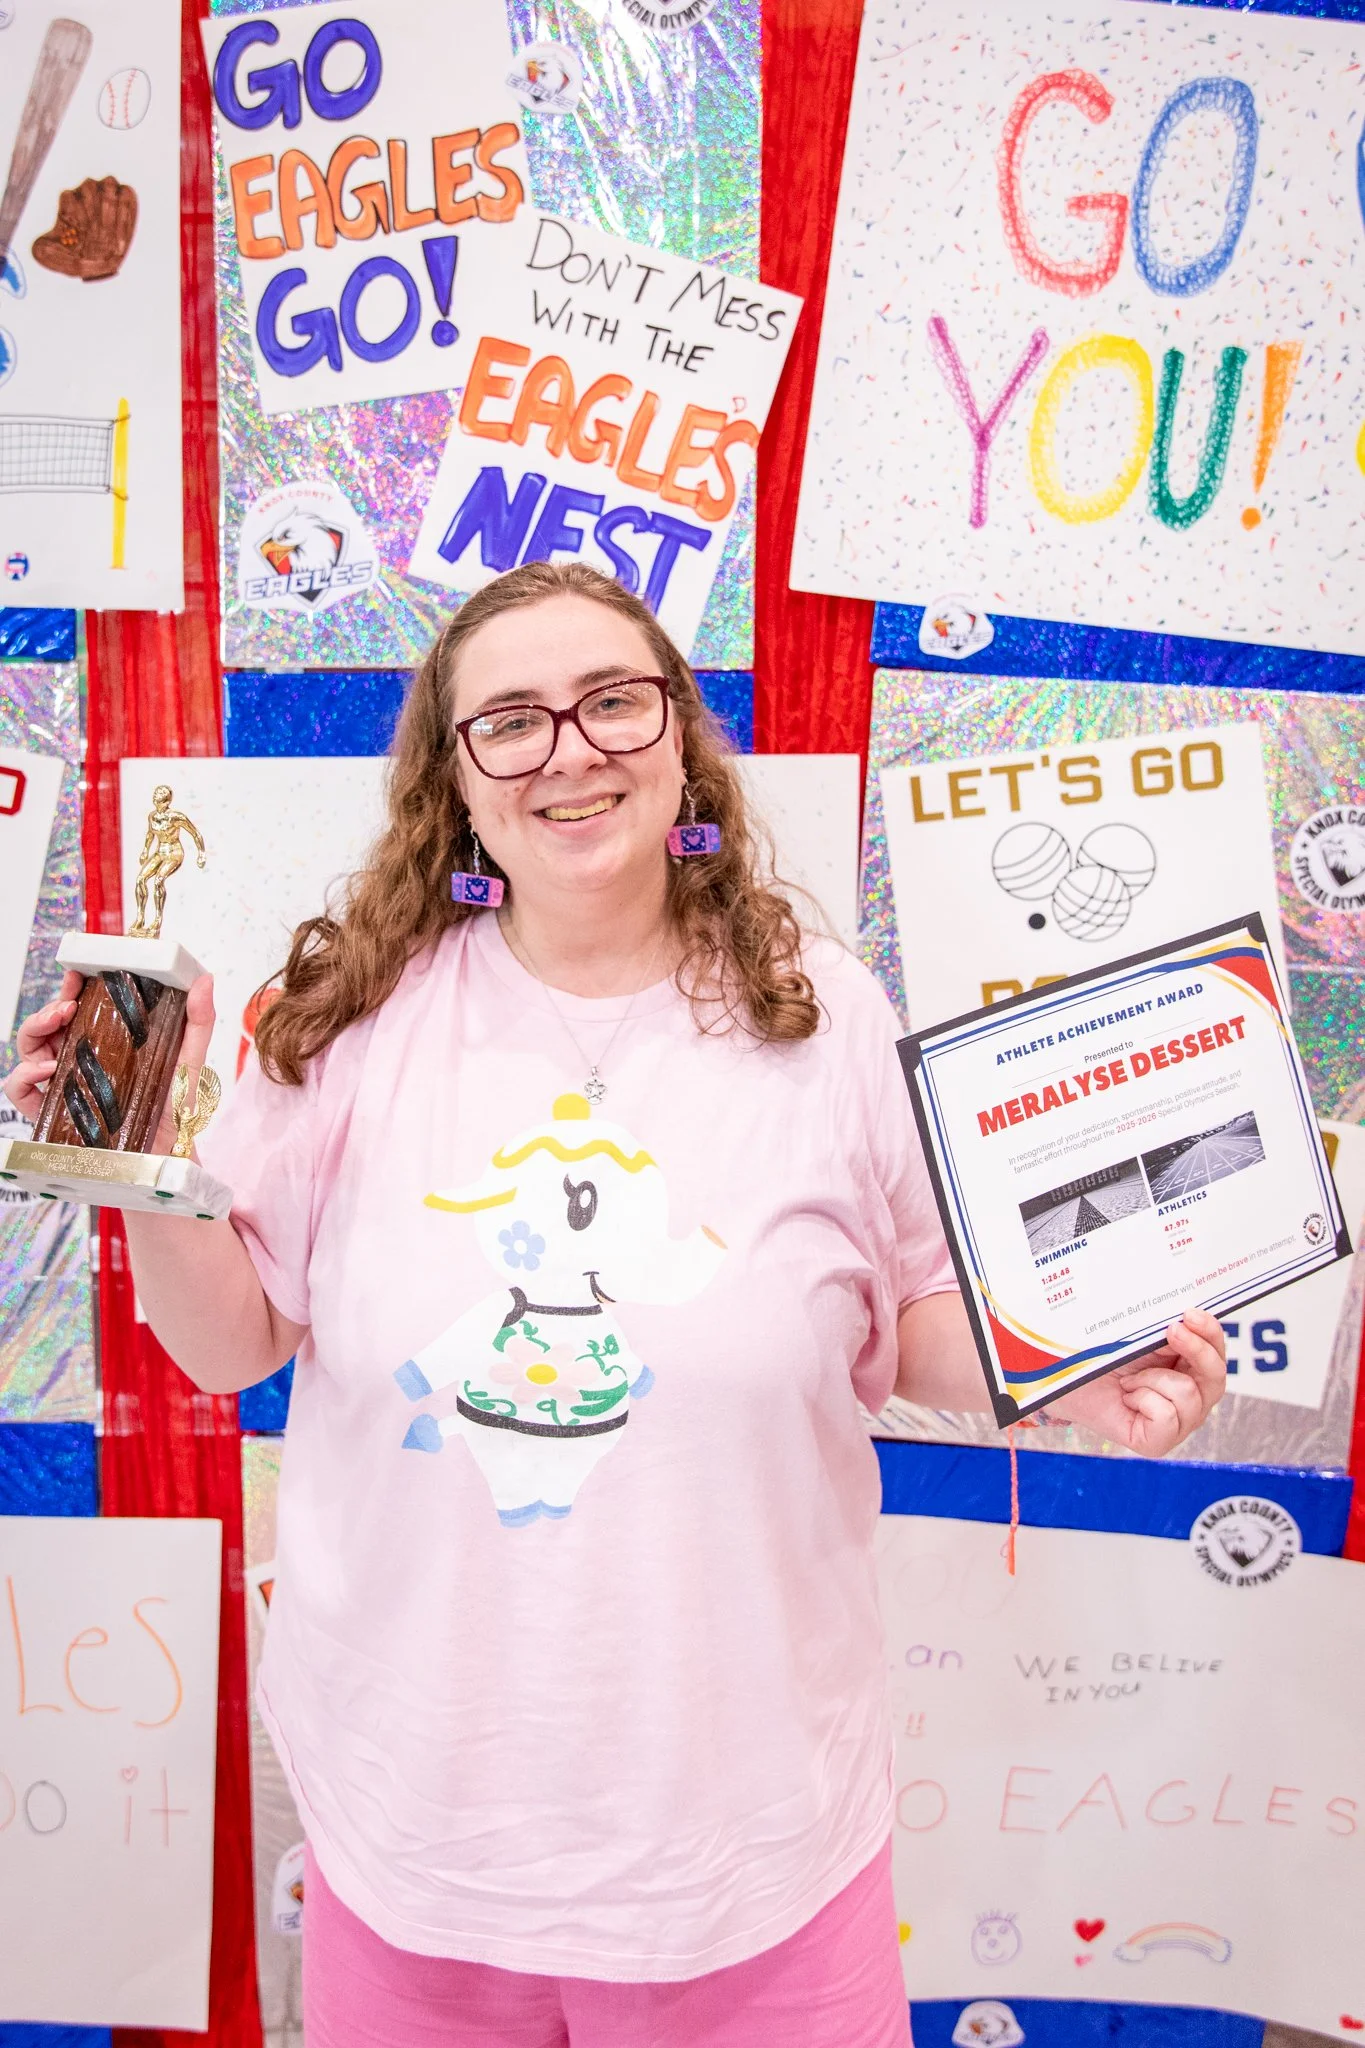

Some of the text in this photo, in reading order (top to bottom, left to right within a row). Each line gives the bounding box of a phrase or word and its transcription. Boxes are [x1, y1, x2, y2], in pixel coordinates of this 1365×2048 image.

[213, 18, 382, 131] GO
[229, 122, 524, 259] EAGLES
[996, 67, 1259, 299] GO
[527, 218, 664, 303] DON'T
[256, 235, 459, 378] GO!
[533, 290, 714, 373] WITH THE
[925, 310, 1304, 532] YOU!
[244, 560, 374, 603] EAGLES
[909, 741, 1225, 824] LET'S GO
[1305, 810, 1344, 839] KNOX
[996, 983, 1204, 1065] ATHLETE ACHIEVEMENT AWARD
[1084, 1040, 1134, 1064] Presented to
[977, 1015, 1246, 1137] MERALYSE DESSERT
[30, 1151, 47, 1161] KNOX
[49, 1153, 74, 1163] COUNTY
[76, 1156, 101, 1167] SPECIAL
[77, 1148, 95, 1158] 2026
[1008, 1157, 1016, 1166] In
[1017, 1141, 1056, 1162] recognition
[1057, 1137, 1064, 1146] of
[1065, 1131, 1081, 1145] your
[1175, 1086, 1200, 1102] positive
[1014, 1156, 1044, 1174] fantastic
[1045, 1148, 1062, 1161] effort
[1063, 1134, 1103, 1153] throughout
[1104, 1128, 1115, 1138] the
[1116, 1112, 1157, 1133] 2025-2026
[1158, 1103, 1183, 1118] Special
[1184, 1092, 1215, 1108] Olympics
[48, 1162, 114, 1177] MERALYSE DESSERT
[1158, 1190, 1207, 1216] ATHLETICS
[1035, 1238, 1088, 1268] SWIMMING
[1085, 1323, 1098, 1335] Let
[1098, 1318, 1110, 1329] me
[1127, 1304, 1141, 1315] But
[1141, 1300, 1148, 1310] if
[1152, 1289, 1179, 1305] cannot
[1195, 1277, 1205, 1287] let
[1206, 1271, 1218, 1281] me
[1218, 1265, 1228, 1276] be
[1228, 1256, 1248, 1271] brave
[1249, 1251, 1256, 1261] in
[1257, 1246, 1269, 1258] the
[1014, 1652, 1224, 1680] WE BELIVE
[1045, 1685, 1083, 1704] IN
[120, 1765, 189, 1849] it
[999, 1765, 1358, 1836] EAGLES
